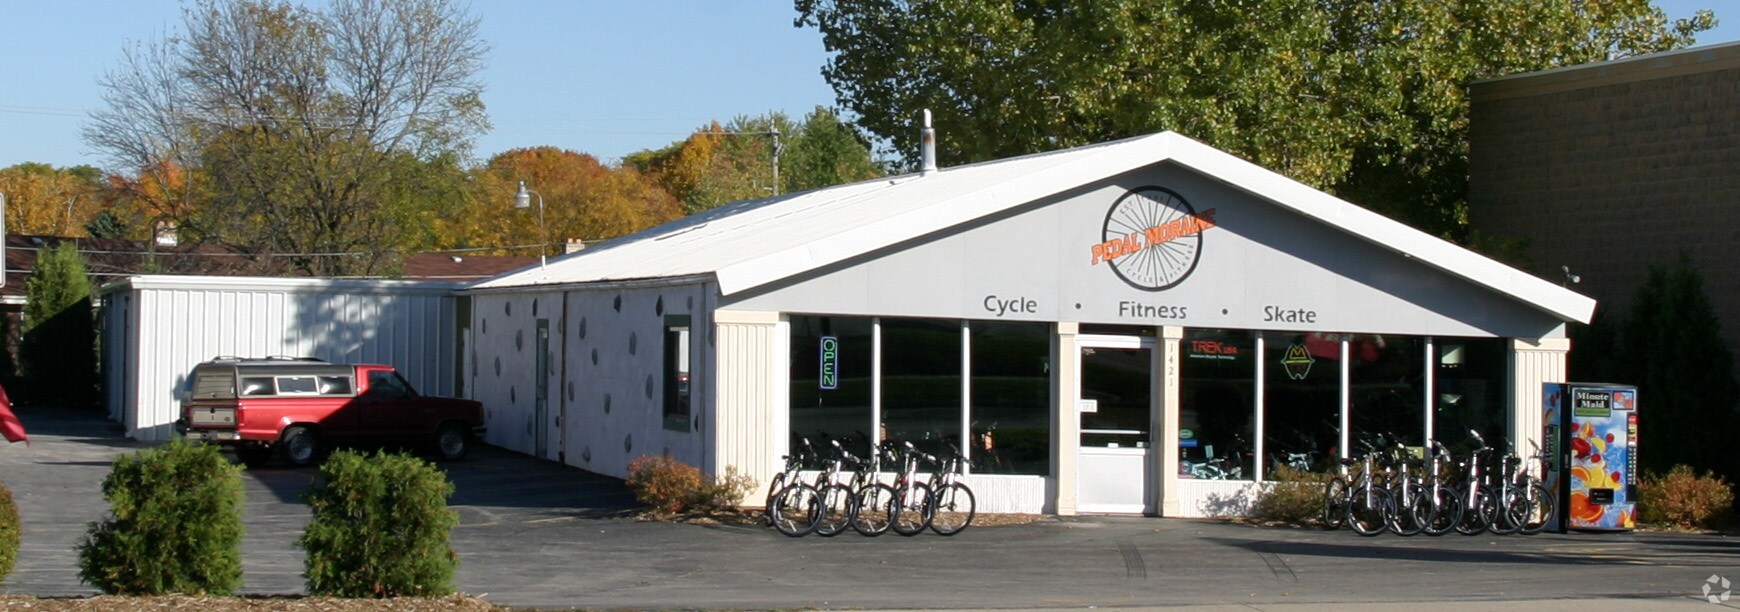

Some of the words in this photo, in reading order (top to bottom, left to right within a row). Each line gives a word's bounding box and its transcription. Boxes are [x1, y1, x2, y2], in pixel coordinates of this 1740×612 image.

[1091, 232, 1141, 266] PEDAL
[1126, 267, 1154, 283] CYCLE
[1169, 244, 1195, 279] FITNESS
[983, 294, 1038, 317] Cycle
[1118, 300, 1188, 320] Fitness
[1263, 305, 1317, 324] Skate
[823, 339, 835, 386] OPEN
[1191, 340, 1223, 355] TREK
[1576, 392, 1609, 400] Minute
[1581, 400, 1605, 408] Maid
